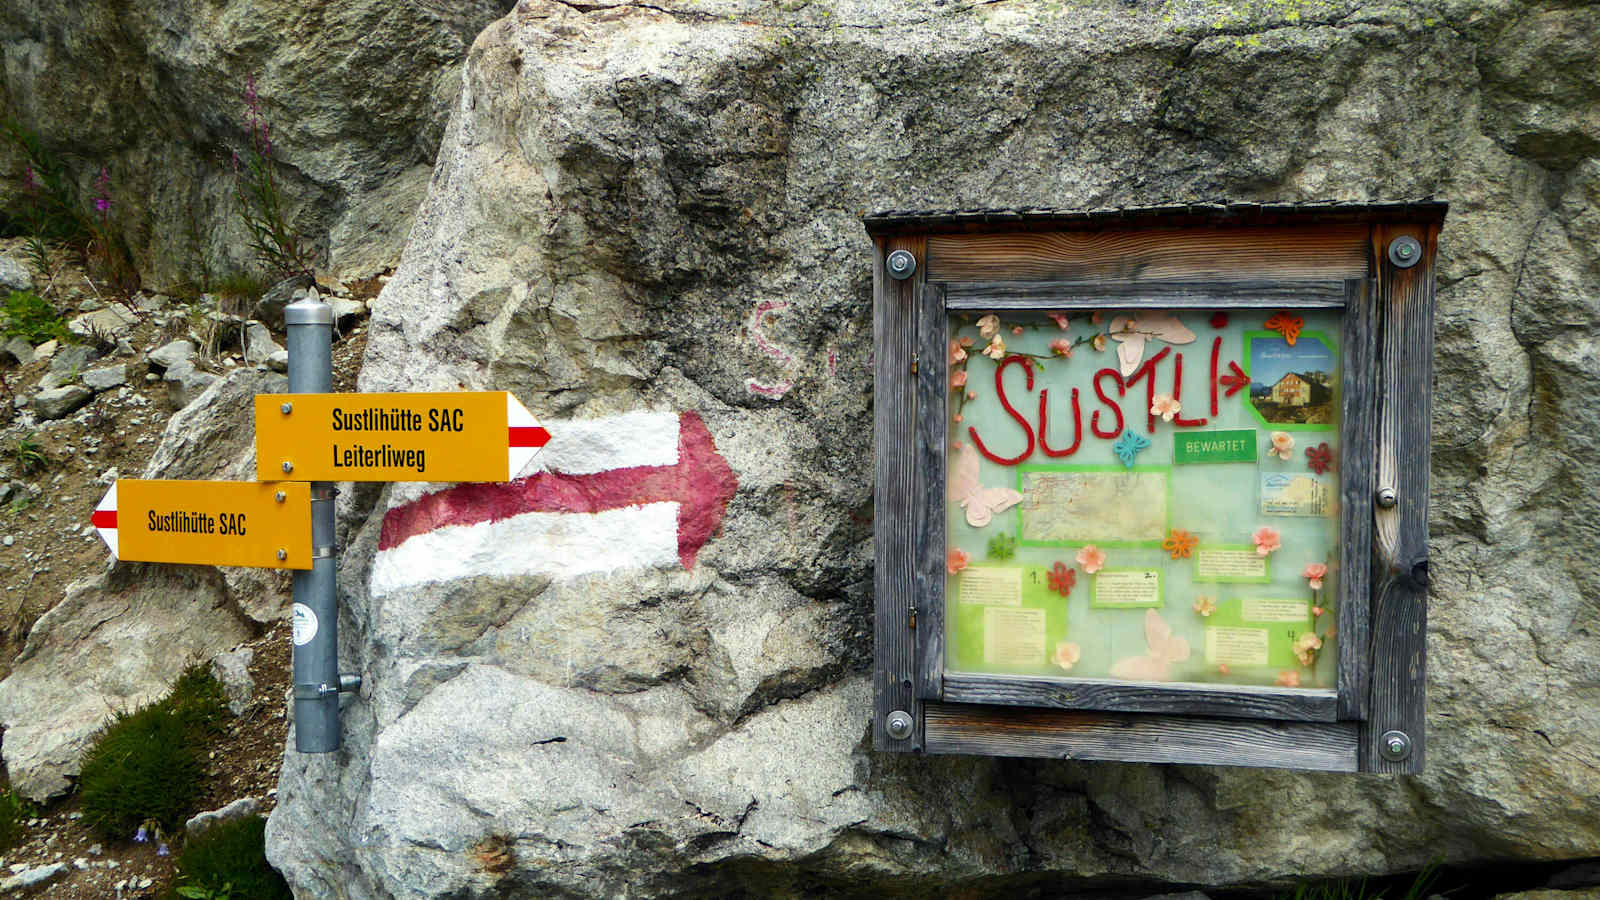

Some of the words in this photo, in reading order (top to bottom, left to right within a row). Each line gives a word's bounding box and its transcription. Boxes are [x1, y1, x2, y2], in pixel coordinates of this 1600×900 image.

[332, 407, 422, 431] Sustlihütte
[428, 408, 464, 432] SAC
[333, 444, 425, 472] Leiterliweg
[1185, 440, 1247, 455] BEWARTET
[148, 509, 215, 534] Sustlihütte
[219, 512, 246, 536] SAC
